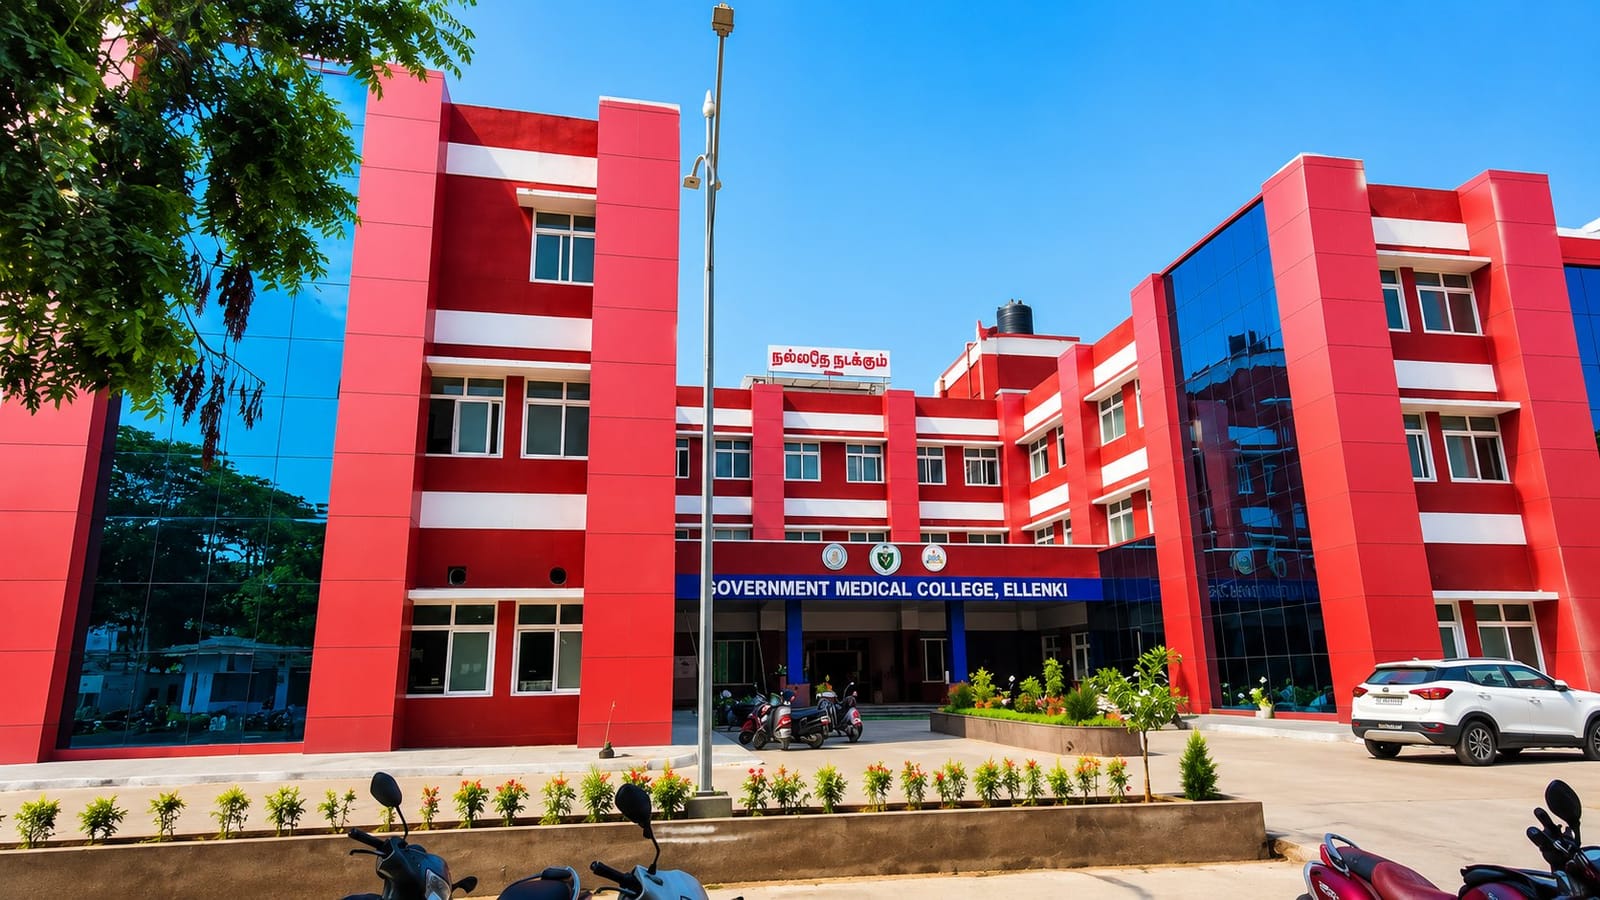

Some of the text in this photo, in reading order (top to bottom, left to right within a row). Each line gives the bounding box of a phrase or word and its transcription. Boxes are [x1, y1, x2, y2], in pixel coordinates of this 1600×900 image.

[834, 352, 888, 370] நடக்கும்
[835, 581, 912, 597] MEDICAL
[917, 582, 999, 599] COLLEGE,
[1003, 582, 1068, 597] ELLENKI
